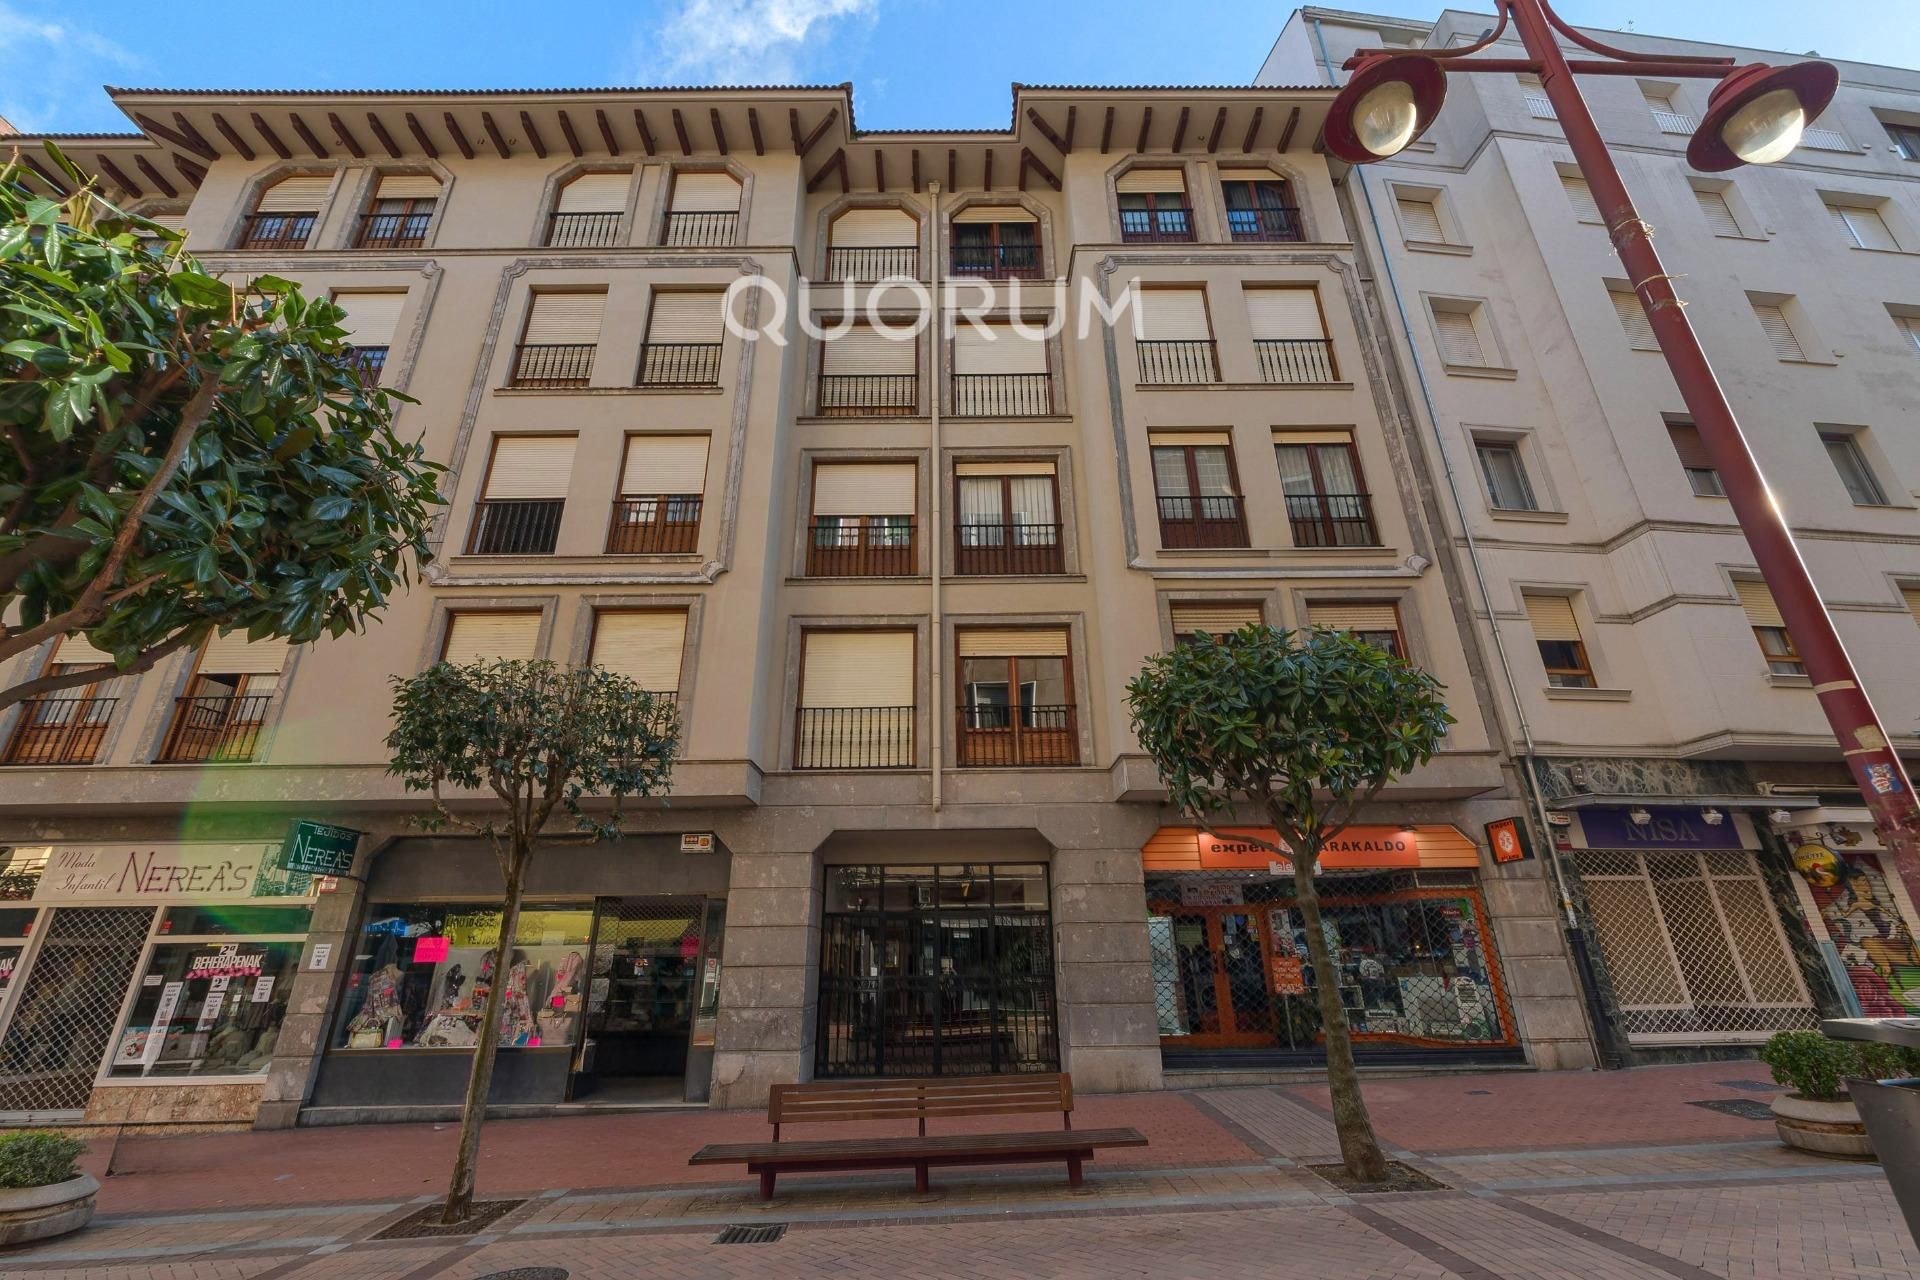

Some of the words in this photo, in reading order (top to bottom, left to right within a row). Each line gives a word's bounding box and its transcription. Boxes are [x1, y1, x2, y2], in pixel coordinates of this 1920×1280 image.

[1623, 818, 1700, 841] NISA
[1211, 844, 1273, 854] exper
[1319, 841, 1406, 852] ARAKALDO
[58, 851, 96, 869] Moda
[56, 872, 116, 894] Infantil
[192, 955, 263, 970] BEHERAPENAK
